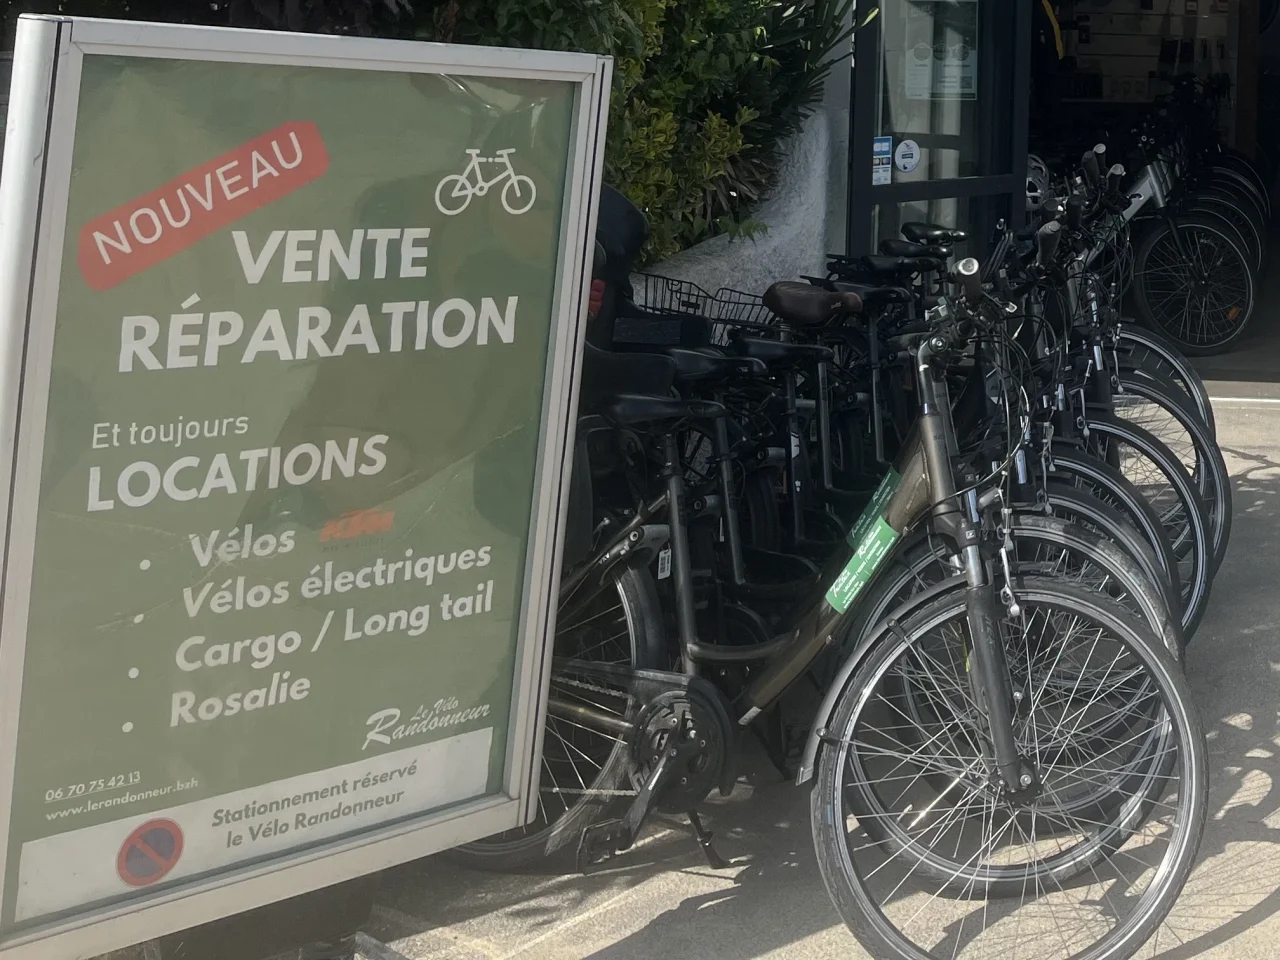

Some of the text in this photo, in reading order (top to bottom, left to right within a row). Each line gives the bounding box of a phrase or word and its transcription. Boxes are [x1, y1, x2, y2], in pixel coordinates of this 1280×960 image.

[92, 131, 303, 265] NOUVEAU
[231, 228, 431, 284] VENTE
[118, 292, 519, 373] RÉPARATION
[92, 416, 250, 449] Et toujours
[87, 434, 390, 512] LOCATIONS
[188, 523, 296, 567] Vélos
[182, 545, 492, 618] Vélos électriques
[175, 580, 495, 672] Cargo / Long tail
[170, 670, 311, 727] Rosalie
[361, 702, 491, 751] Randonneur
[410, 696, 459, 722] Le Vélo
[45, 771, 141, 801] 06 70 75 42 13
[46, 777, 199, 821] www.lerandonneur.bzh
[211, 759, 418, 827] Stationnement réservé
[226, 790, 405, 848] le Vélo Randonneur
